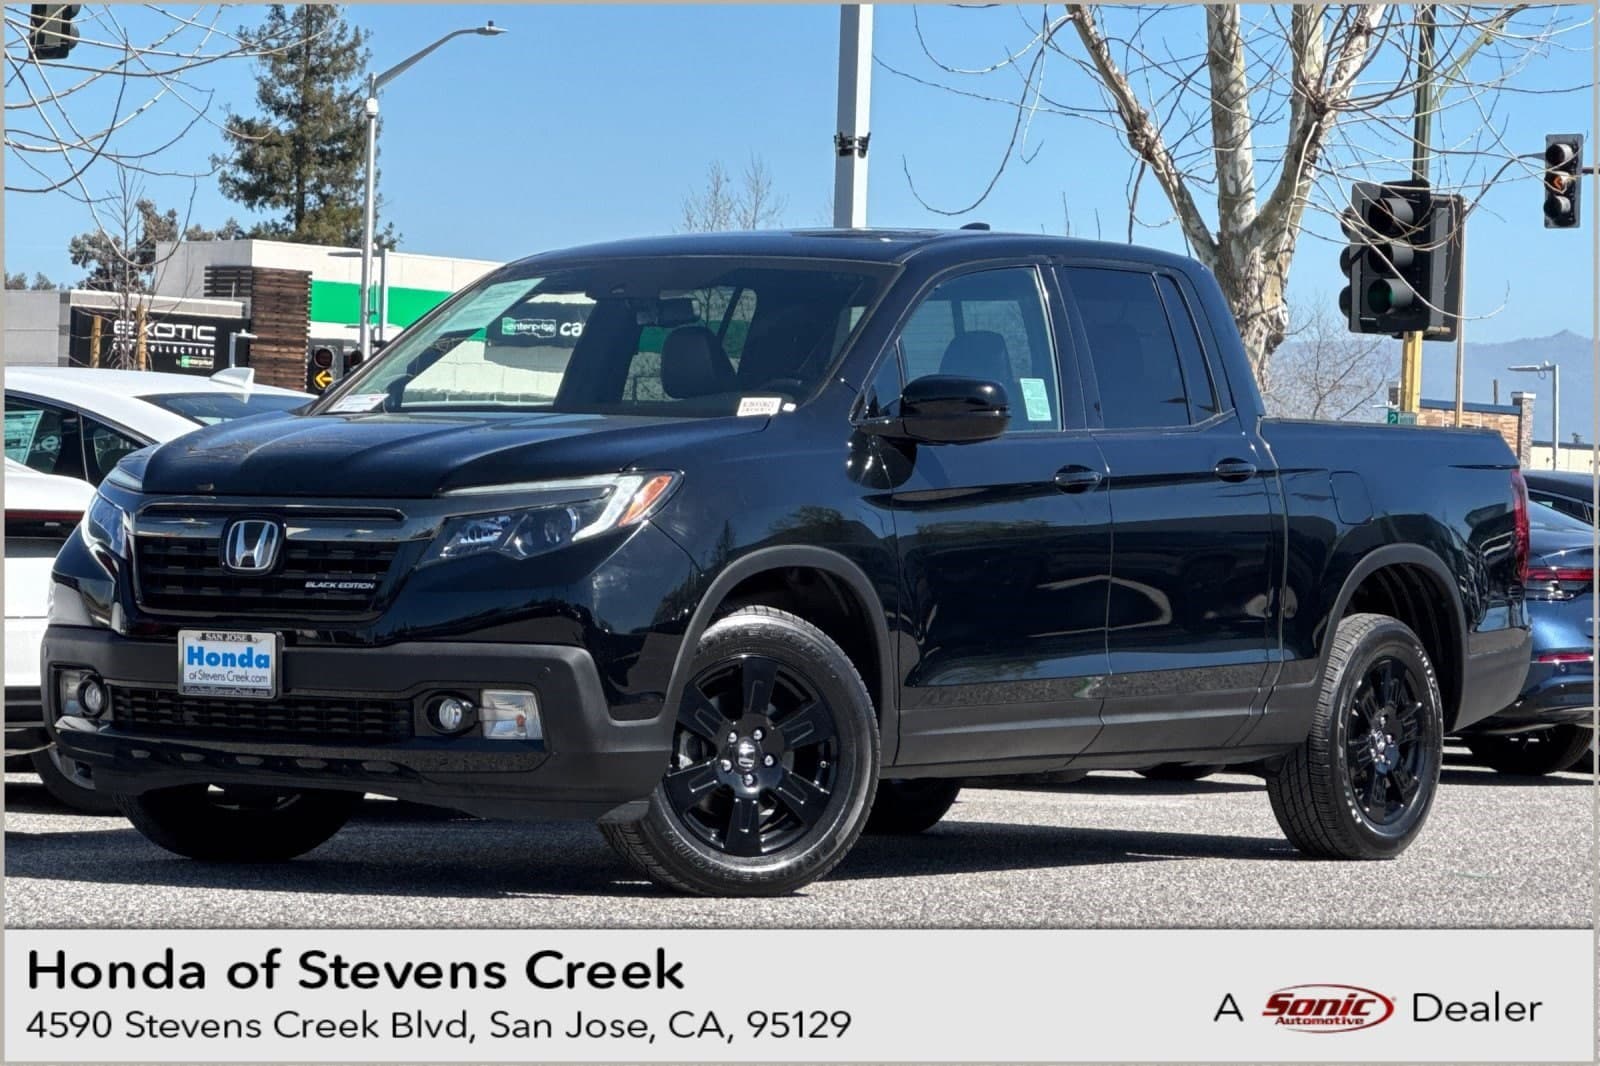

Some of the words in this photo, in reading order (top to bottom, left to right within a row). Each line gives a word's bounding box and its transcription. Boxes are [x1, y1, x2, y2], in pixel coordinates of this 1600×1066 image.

[560, 321, 587, 337] ca
[143, 344, 215, 356] OLLECTION
[305, 581, 337, 589] BLACK
[338, 582, 375, 590] EDITION
[206, 632, 223, 641] SAN
[187, 645, 270, 669] Honda
[189, 671, 197, 681] of
